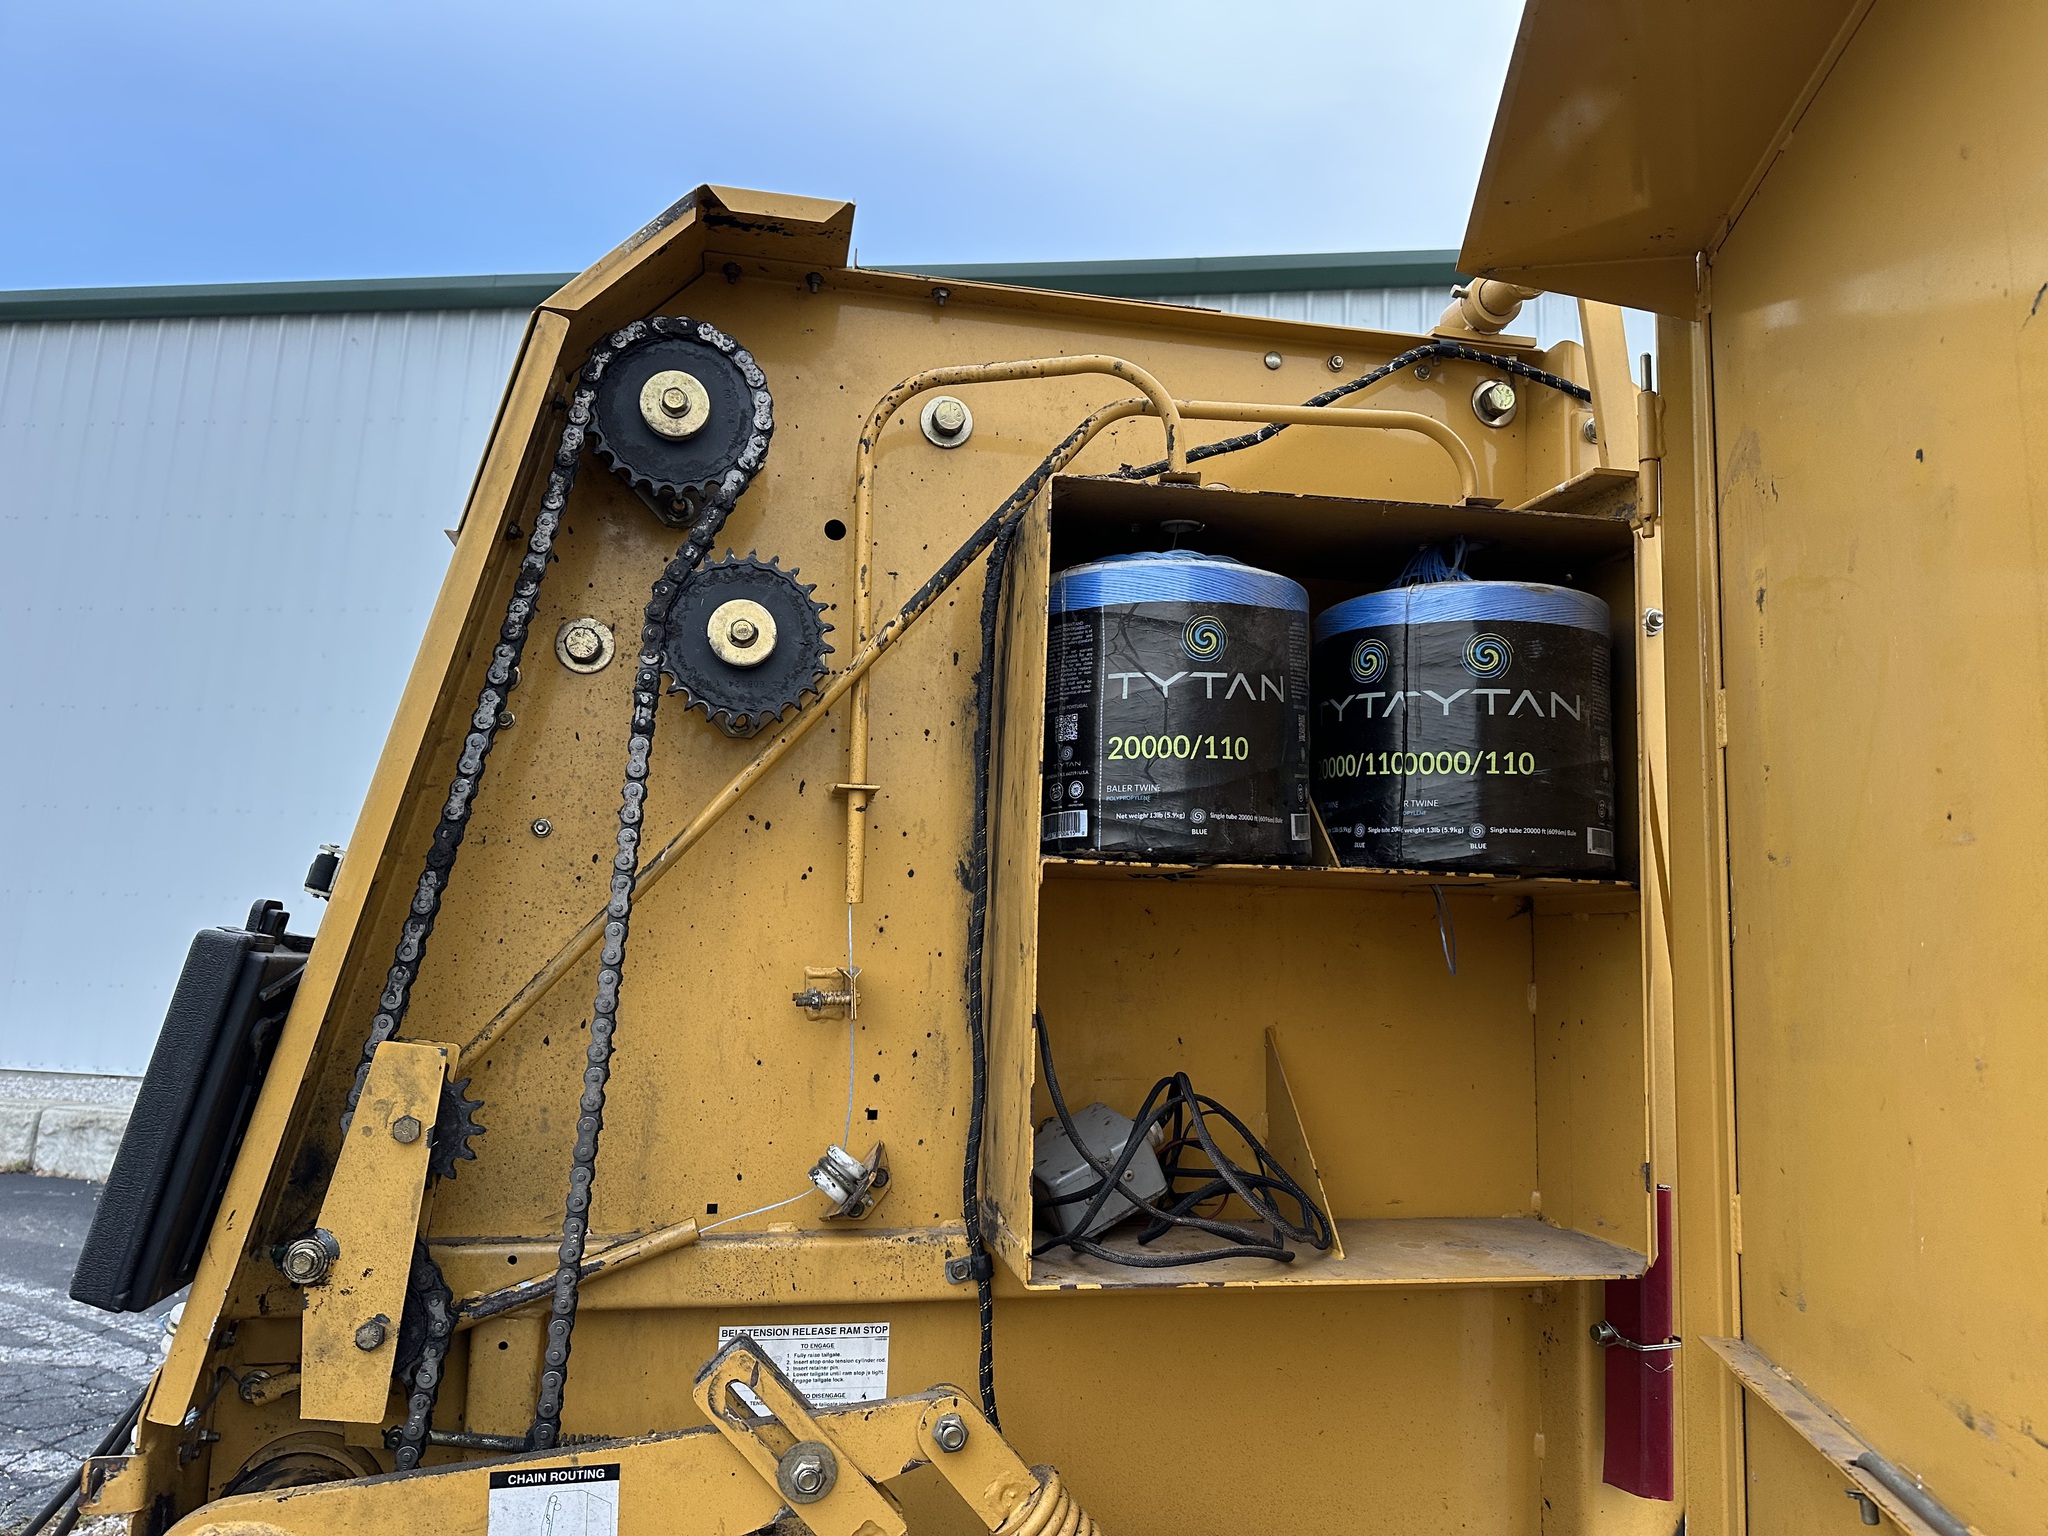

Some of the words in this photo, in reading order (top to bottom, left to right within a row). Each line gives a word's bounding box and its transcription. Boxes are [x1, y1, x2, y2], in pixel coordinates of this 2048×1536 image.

[1108, 671, 1285, 703] TYTAN
[1317, 690, 1406, 725] TYTA
[1108, 735, 1249, 761] 20000/110
[1106, 784, 1133, 793] BALER
[1134, 784, 1161, 792] TWINE
[1210, 812, 1225, 820] Single
[1238, 813, 1253, 821] 20000
[1367, 826, 1380, 834] Single
[1404, 827, 1425, 835] weight
[1441, 826, 1465, 834] (5.9kg)
[1489, 826, 1508, 834] Single
[747, 1328, 790, 1337] TENSION
[792, 1326, 837, 1336] RELEASE
[839, 1326, 860, 1335] RAM
[863, 1325, 888, 1334] STOP
[507, 1472, 547, 1485] CHAIN
[549, 1468, 605, 1482] ROUTING
